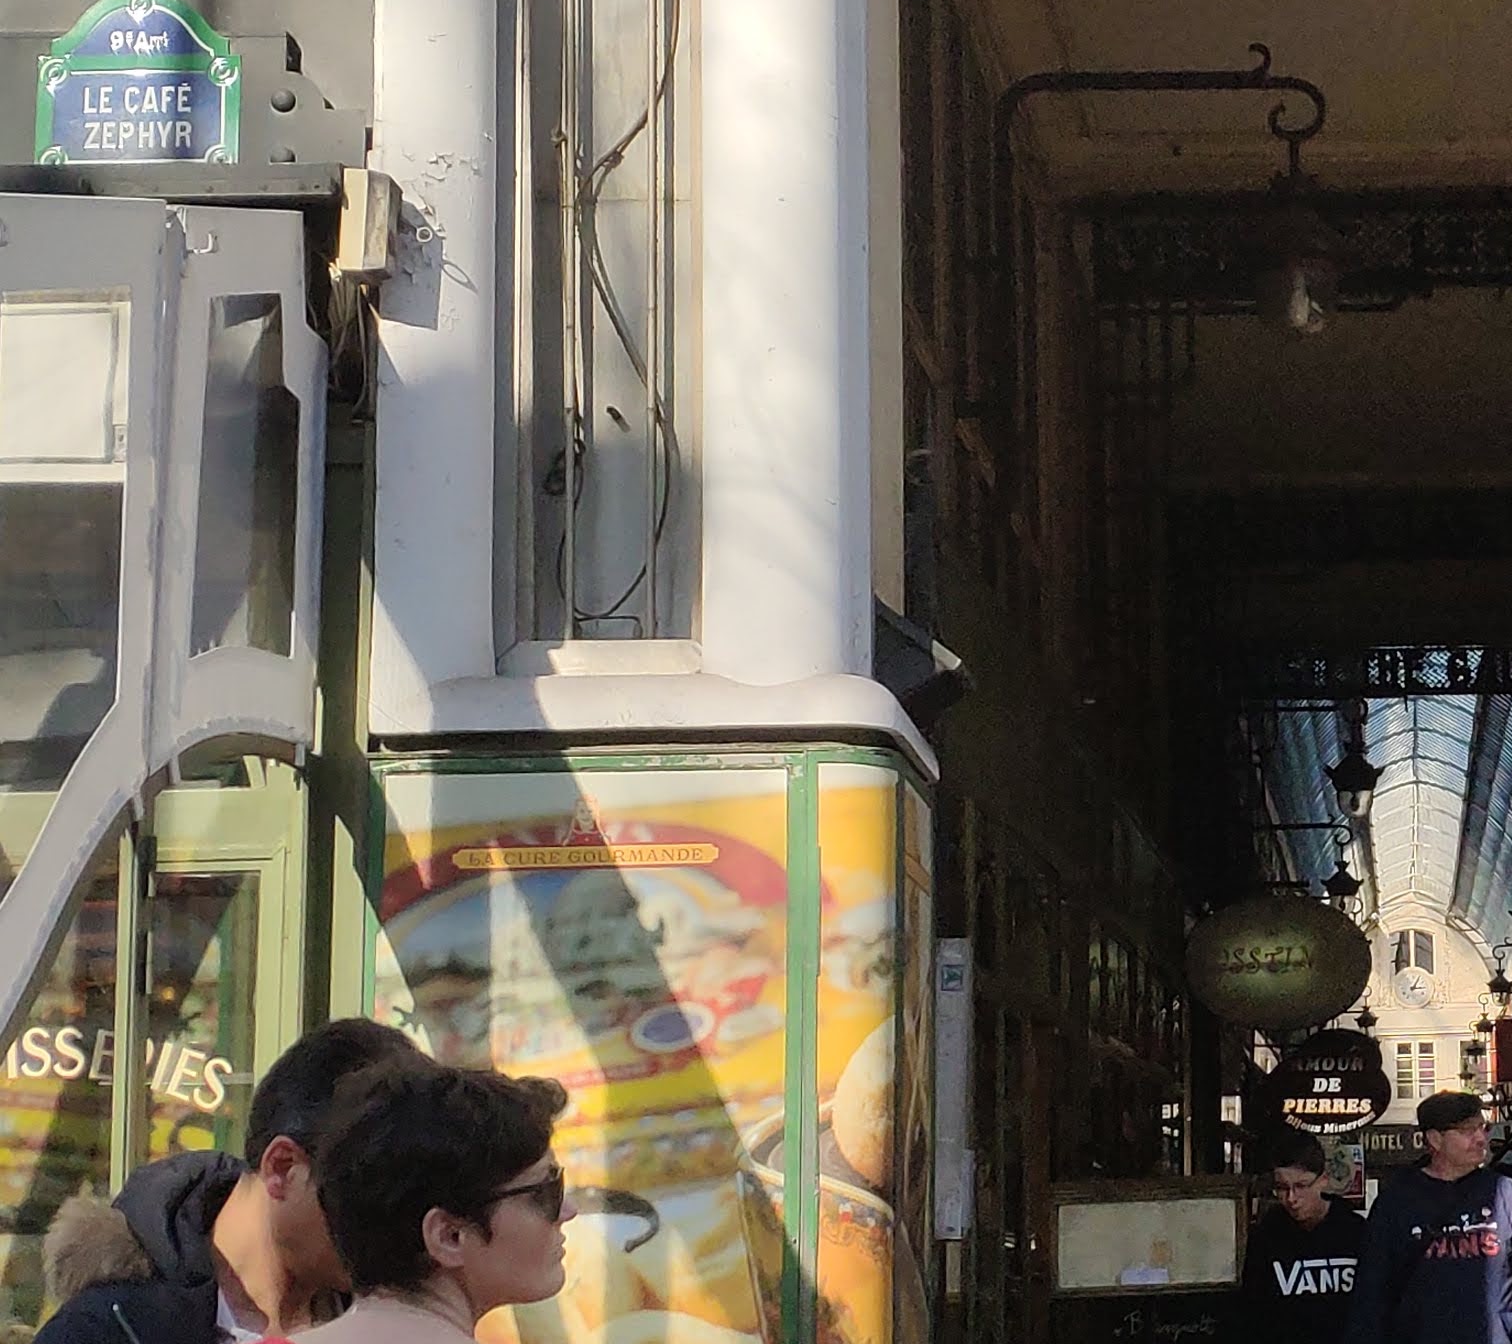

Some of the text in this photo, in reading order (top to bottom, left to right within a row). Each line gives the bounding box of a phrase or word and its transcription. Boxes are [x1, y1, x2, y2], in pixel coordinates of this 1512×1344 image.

[83, 82, 193, 115] LE CAFÉ
[83, 120, 193, 150] ZEPHYR
[468, 847, 704, 866] LA CURE GOURMANDE
[1312, 1077, 1342, 1093] DE
[1282, 1098, 1372, 1114] PIERRES
[1273, 1258, 1358, 1296] VANS
